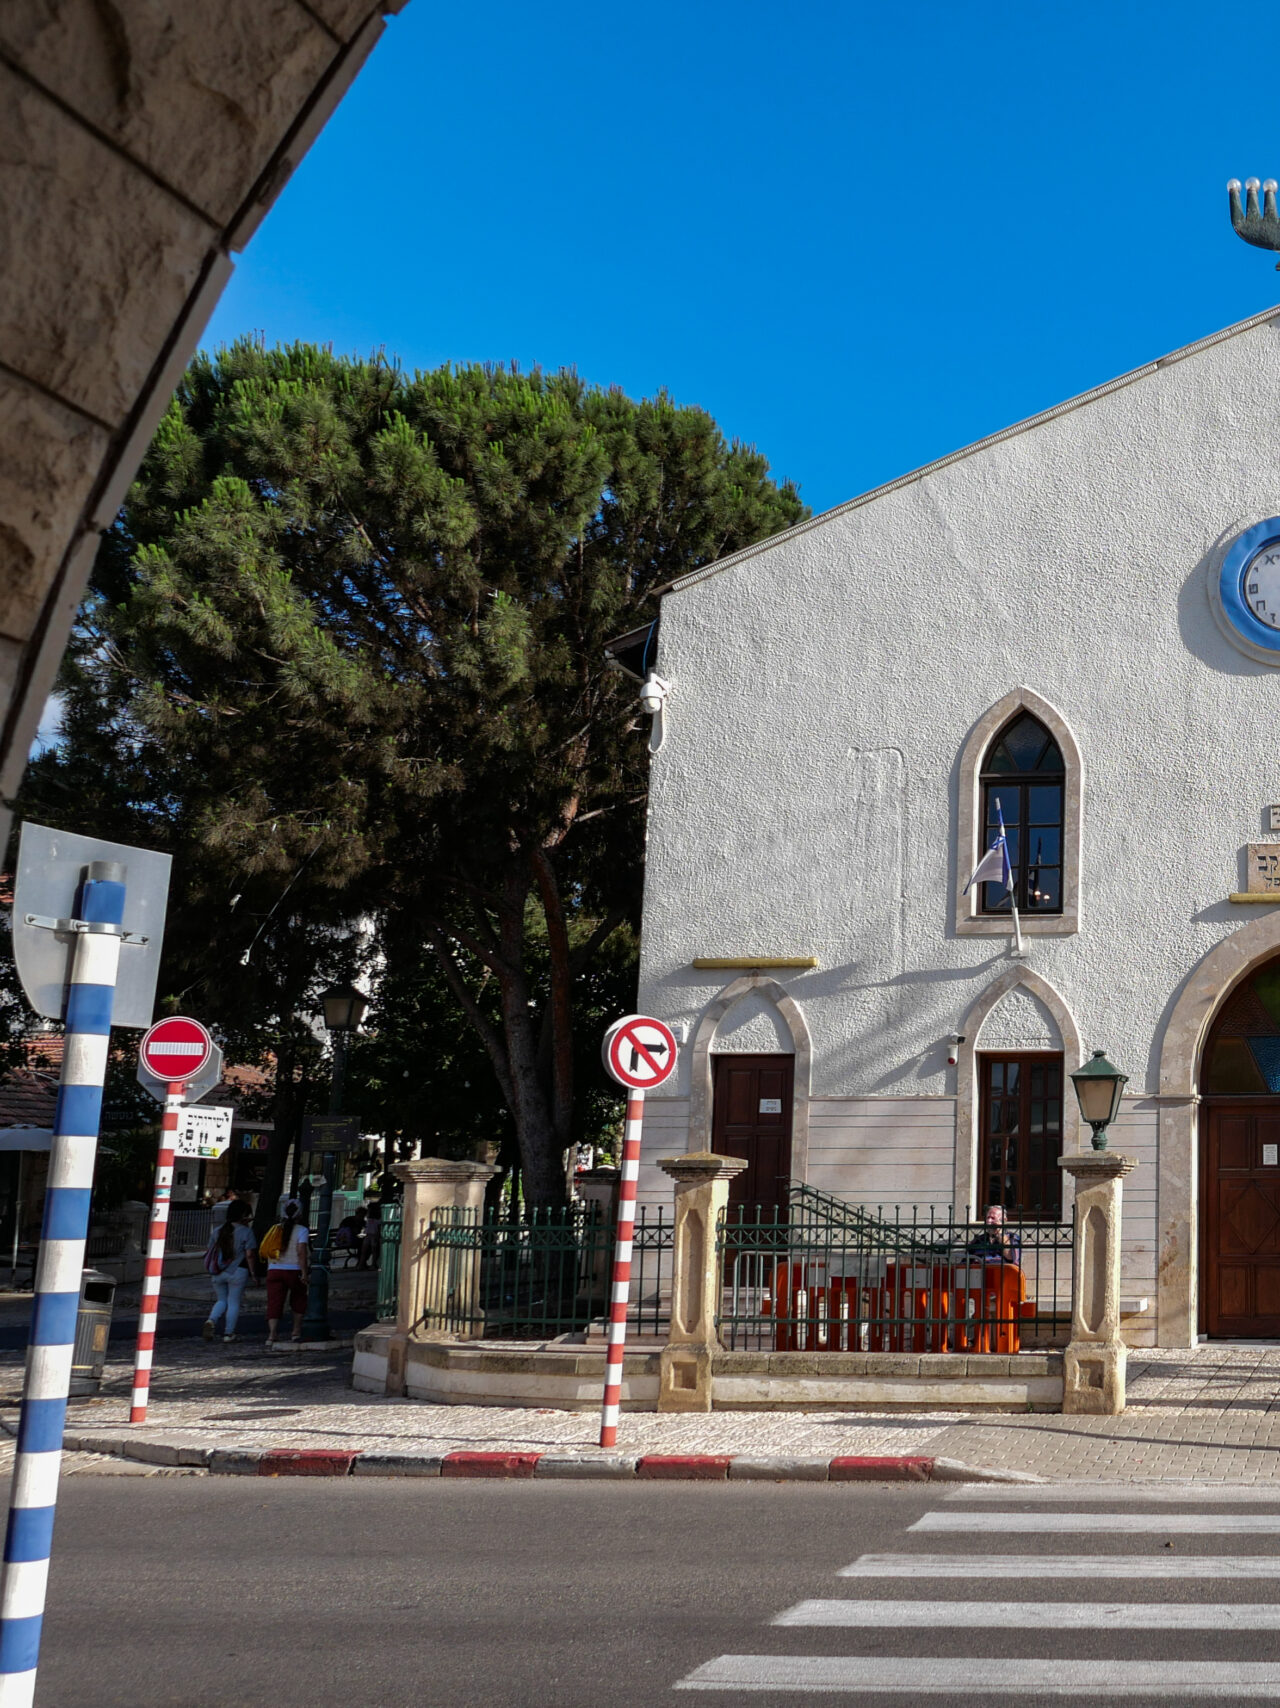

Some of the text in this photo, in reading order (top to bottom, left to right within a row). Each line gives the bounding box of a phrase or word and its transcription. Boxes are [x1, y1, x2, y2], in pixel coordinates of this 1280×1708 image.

[1266, 555, 1280, 564] יא
[1256, 601, 1266, 610] ח
[242, 1133, 268, 1150] RKD
